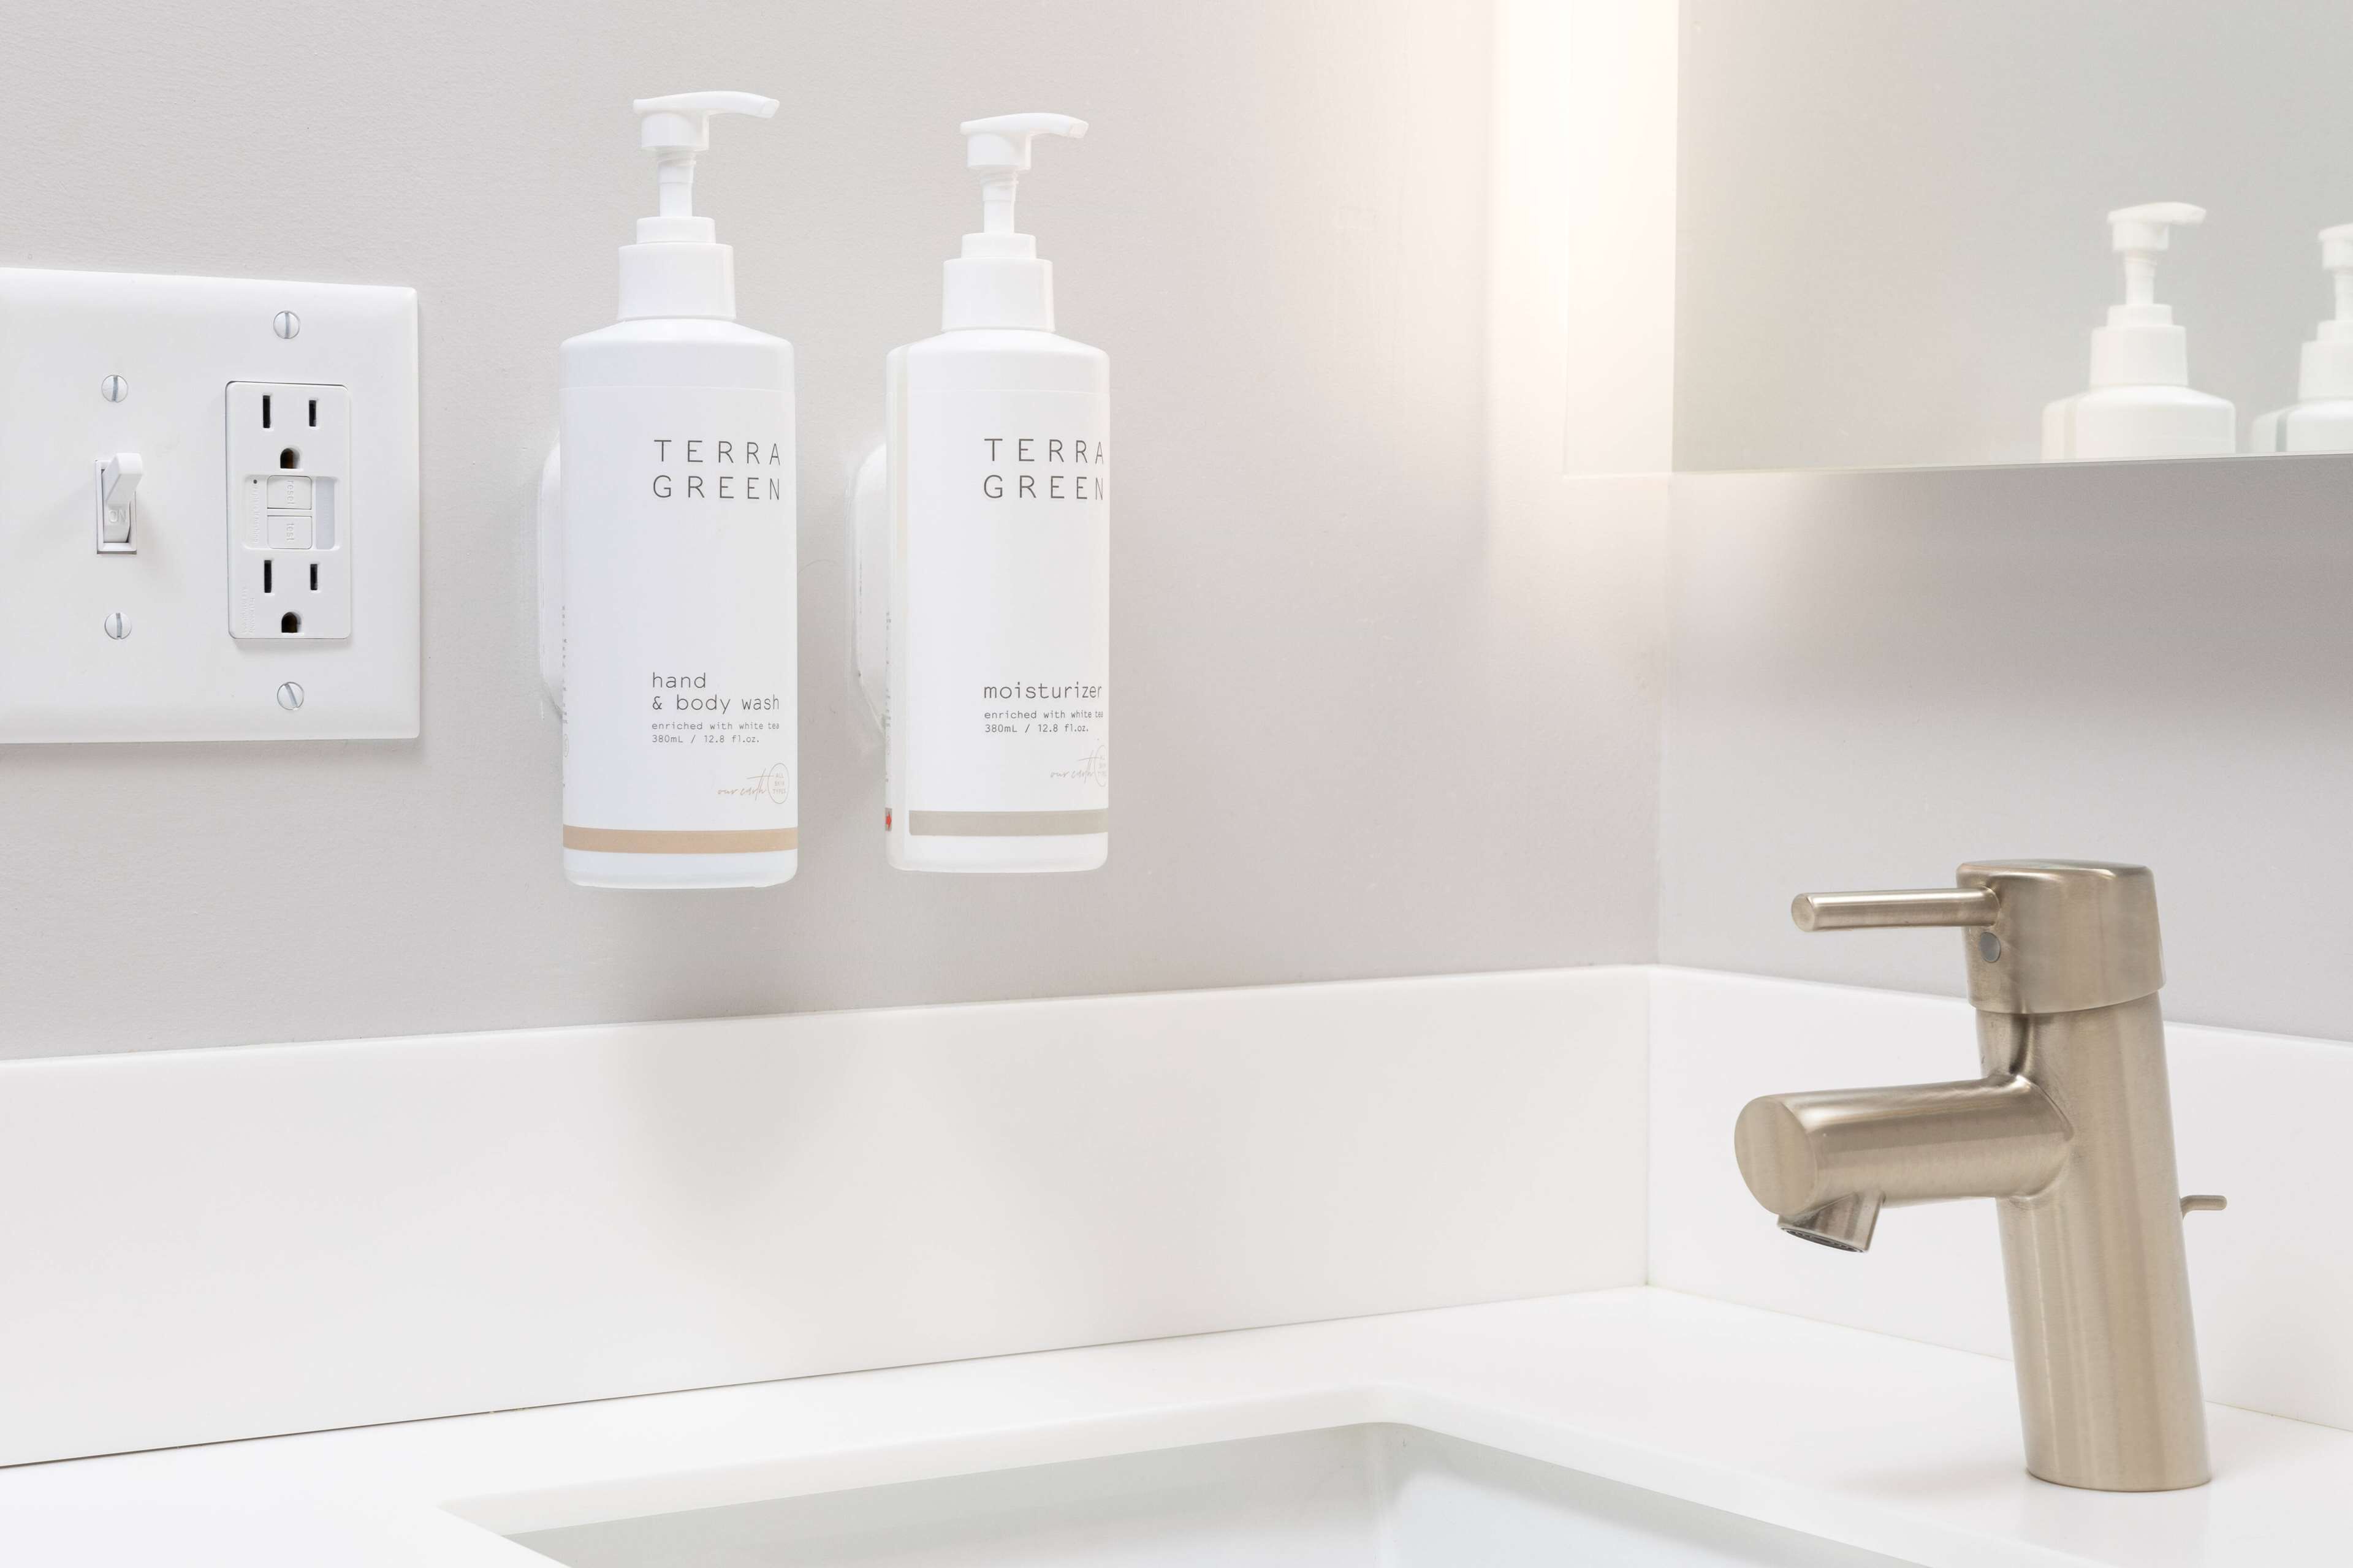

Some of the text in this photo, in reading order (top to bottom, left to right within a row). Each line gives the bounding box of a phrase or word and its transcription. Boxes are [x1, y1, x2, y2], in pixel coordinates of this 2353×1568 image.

[653, 439, 781, 466] TERRA
[984, 438, 1104, 464] TERRA
[653, 474, 780, 501] GREEN
[984, 474, 1103, 501] GREEN
[652, 671, 706, 689] hand
[984, 681, 1102, 699] moisturizer
[652, 694, 780, 715] & body wash
[984, 710, 1037, 719] enriched
[1043, 710, 1066, 719] with
[1070, 710, 1092, 719] white
[652, 721, 703, 730] enriched
[709, 721, 733, 730] with
[739, 721, 764, 730] white
[984, 723, 1089, 733] 380mL / 12.8 fl.oz.
[652, 734, 760, 744] 380mL / 12.8 fl.oz.
